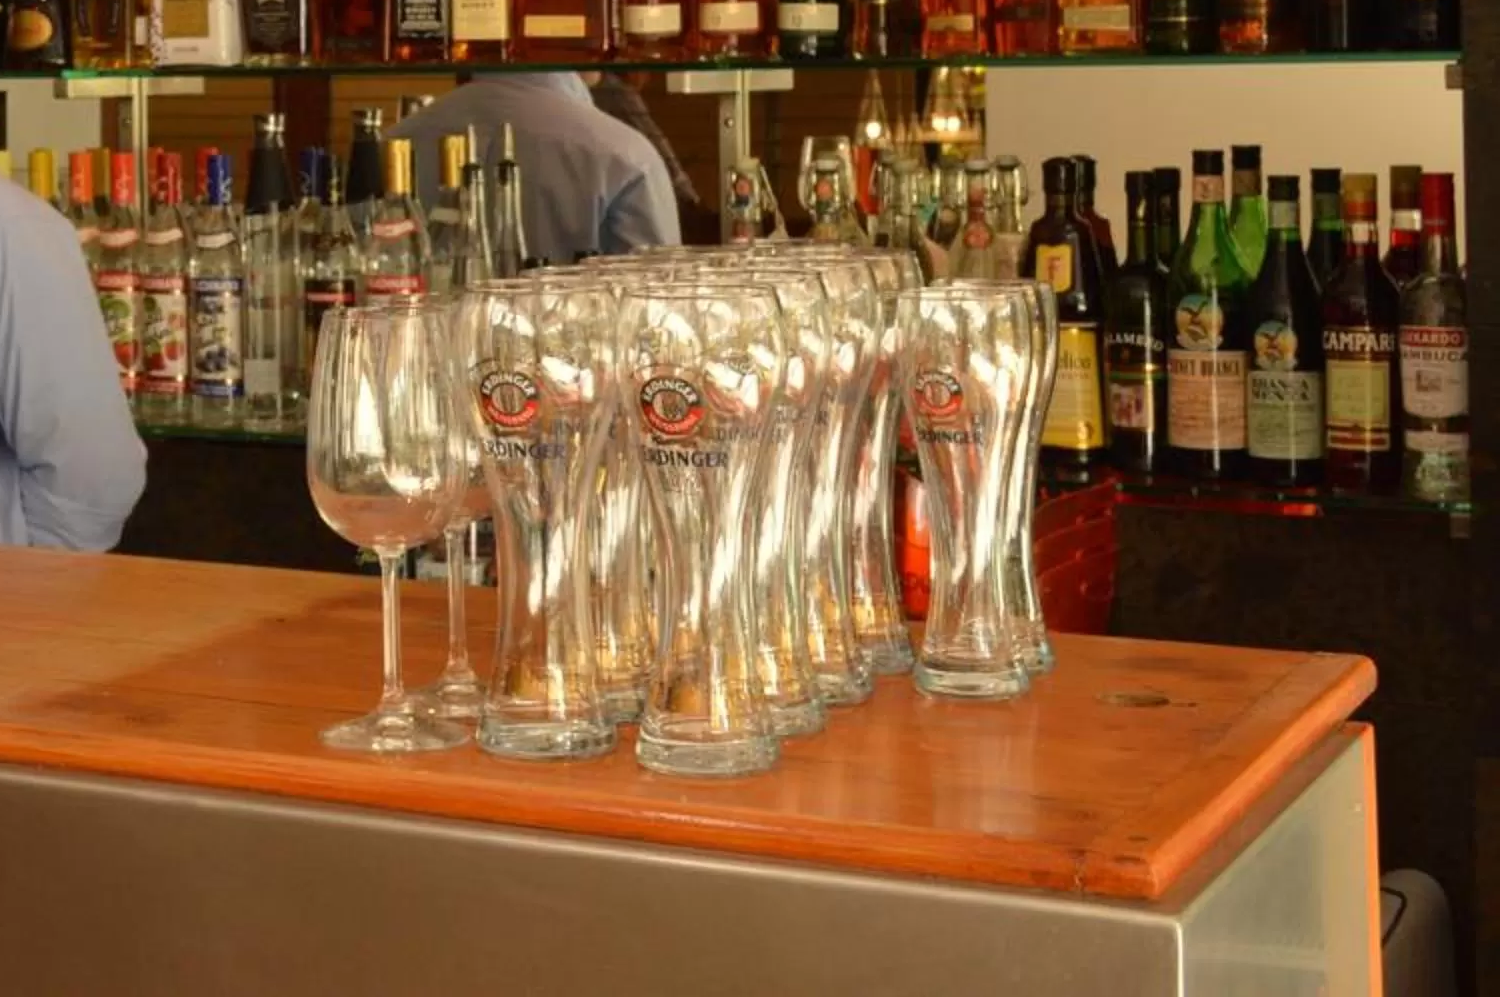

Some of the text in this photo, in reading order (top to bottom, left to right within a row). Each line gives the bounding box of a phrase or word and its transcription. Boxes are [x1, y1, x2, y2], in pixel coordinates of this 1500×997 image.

[1323, 330, 1395, 352] CAMPARI
[480, 371, 537, 397] ERDINGER
[641, 377, 698, 403] ERDINGER
[483, 438, 568, 460] RDINGER
